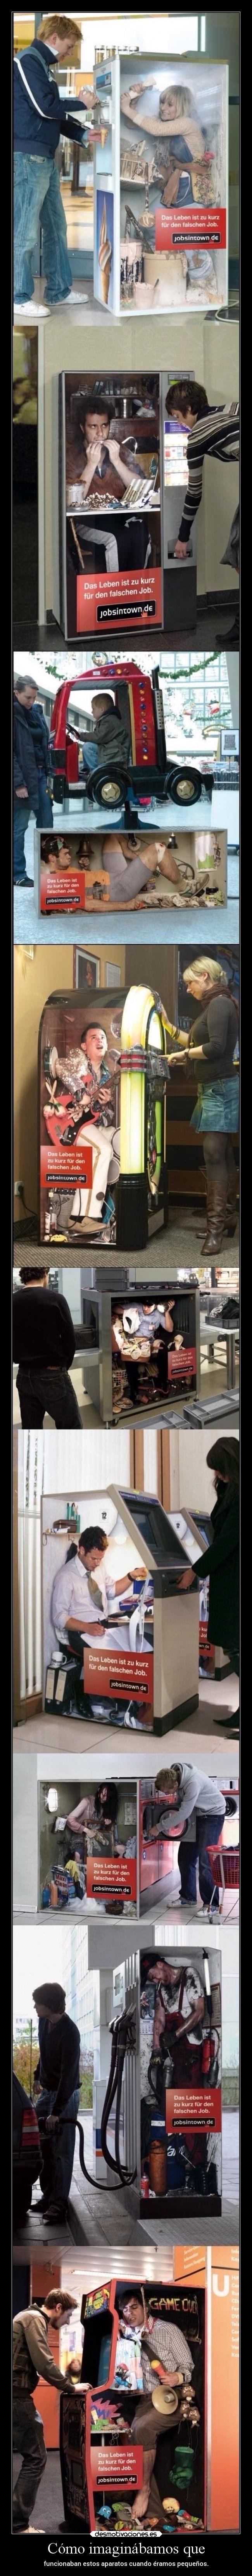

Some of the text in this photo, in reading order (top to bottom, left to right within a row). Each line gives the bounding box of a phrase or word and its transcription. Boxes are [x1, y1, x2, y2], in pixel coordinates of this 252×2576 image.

[109, 1666, 133, 1674] falschen
[55, 1873, 66, 1882] Maxi
[55, 1880, 67, 1889] Clean
[213, 2274, 229, 2297] U
[148, 2298, 180, 2311] GAME
